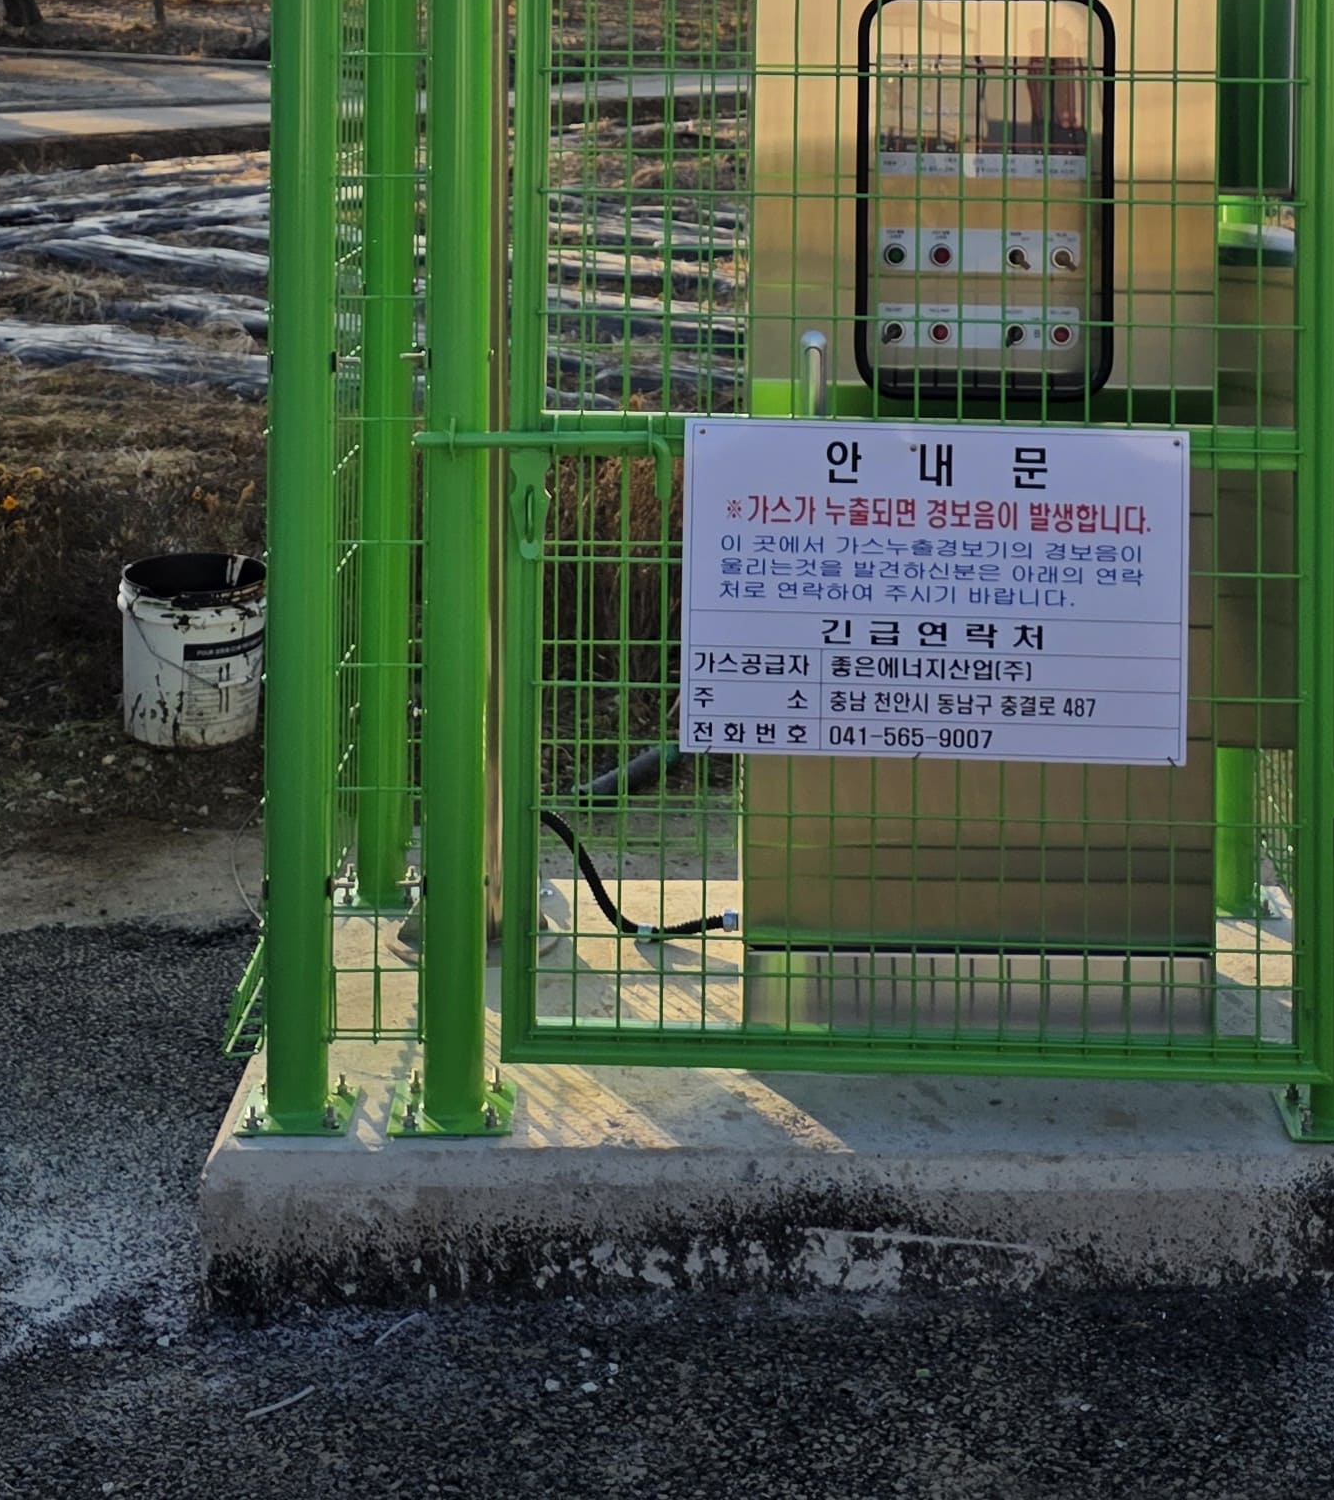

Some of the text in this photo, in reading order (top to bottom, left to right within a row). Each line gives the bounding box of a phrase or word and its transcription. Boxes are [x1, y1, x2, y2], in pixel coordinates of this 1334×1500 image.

[825, 497, 916, 527] 누출되면
[927, 499, 1018, 531] 경보음이
[1029, 502, 1152, 534] 발생합니다.
[721, 534, 1142, 563] 이 곳에서 가스누출경보기의 경보음이
[720, 557, 1144, 587] 울리는것을 발견하신분은 아래의 연락
[719, 580, 1075, 608] 처로 연락하여 주시기 바랍니다.
[694, 652, 1032, 682] 가스공급자 좋은에너지산업(주)
[830, 690, 867, 712] 충남
[874, 691, 929, 714] 천안시
[937, 693, 993, 716] 동남구
[1063, 697, 1096, 718] 487
[829, 725, 993, 749] 041-565-9007
